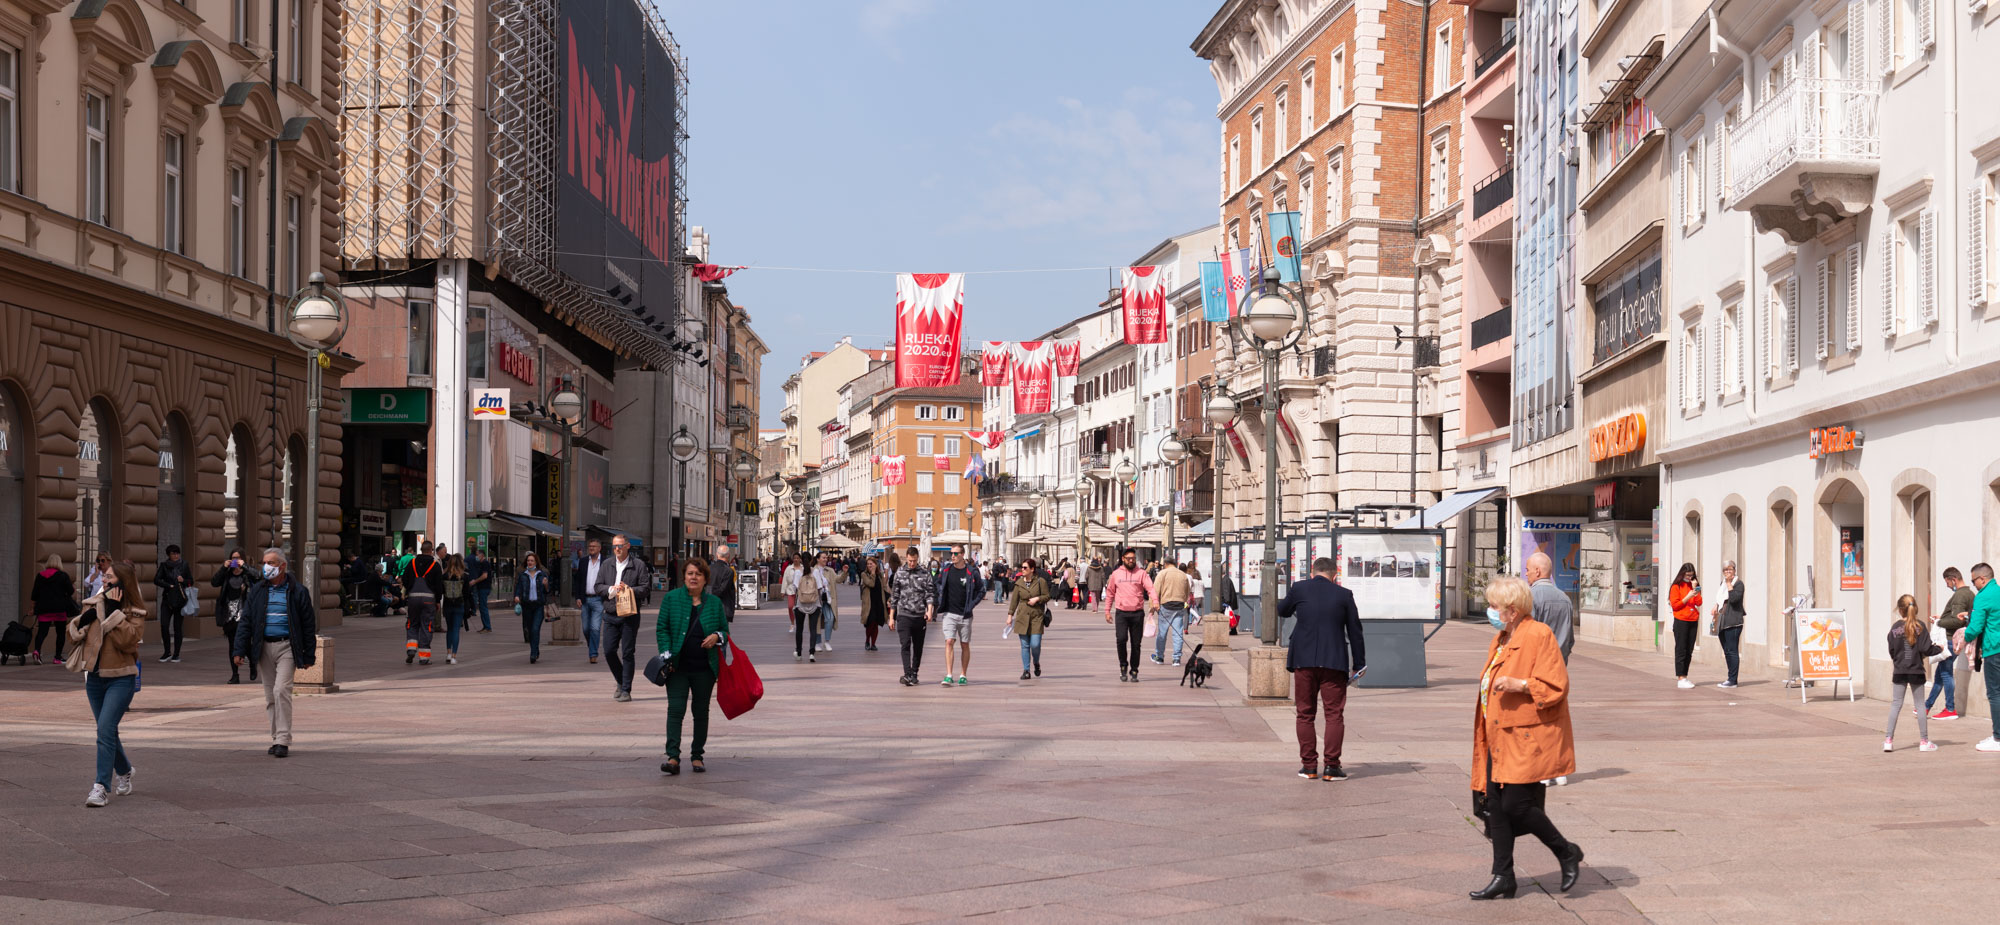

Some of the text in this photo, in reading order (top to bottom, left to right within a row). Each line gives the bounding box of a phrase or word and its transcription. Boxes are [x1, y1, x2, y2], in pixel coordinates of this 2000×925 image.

[1129, 308, 1159, 317] RIJEKA
[905, 333, 952, 346] RIJEKA
[904, 344, 952, 358] 2020.eu
[502, 343, 534, 386] ROBNA
[1019, 378, 1047, 387] RIJEKA
[380, 393, 397, 411] D
[479, 393, 503, 408] dm
[1589, 413, 1645, 463] KORZO
[1821, 426, 1856, 455] Müller
[79, 440, 98, 461] ZARA
[550, 465, 559, 508] OTKUP
